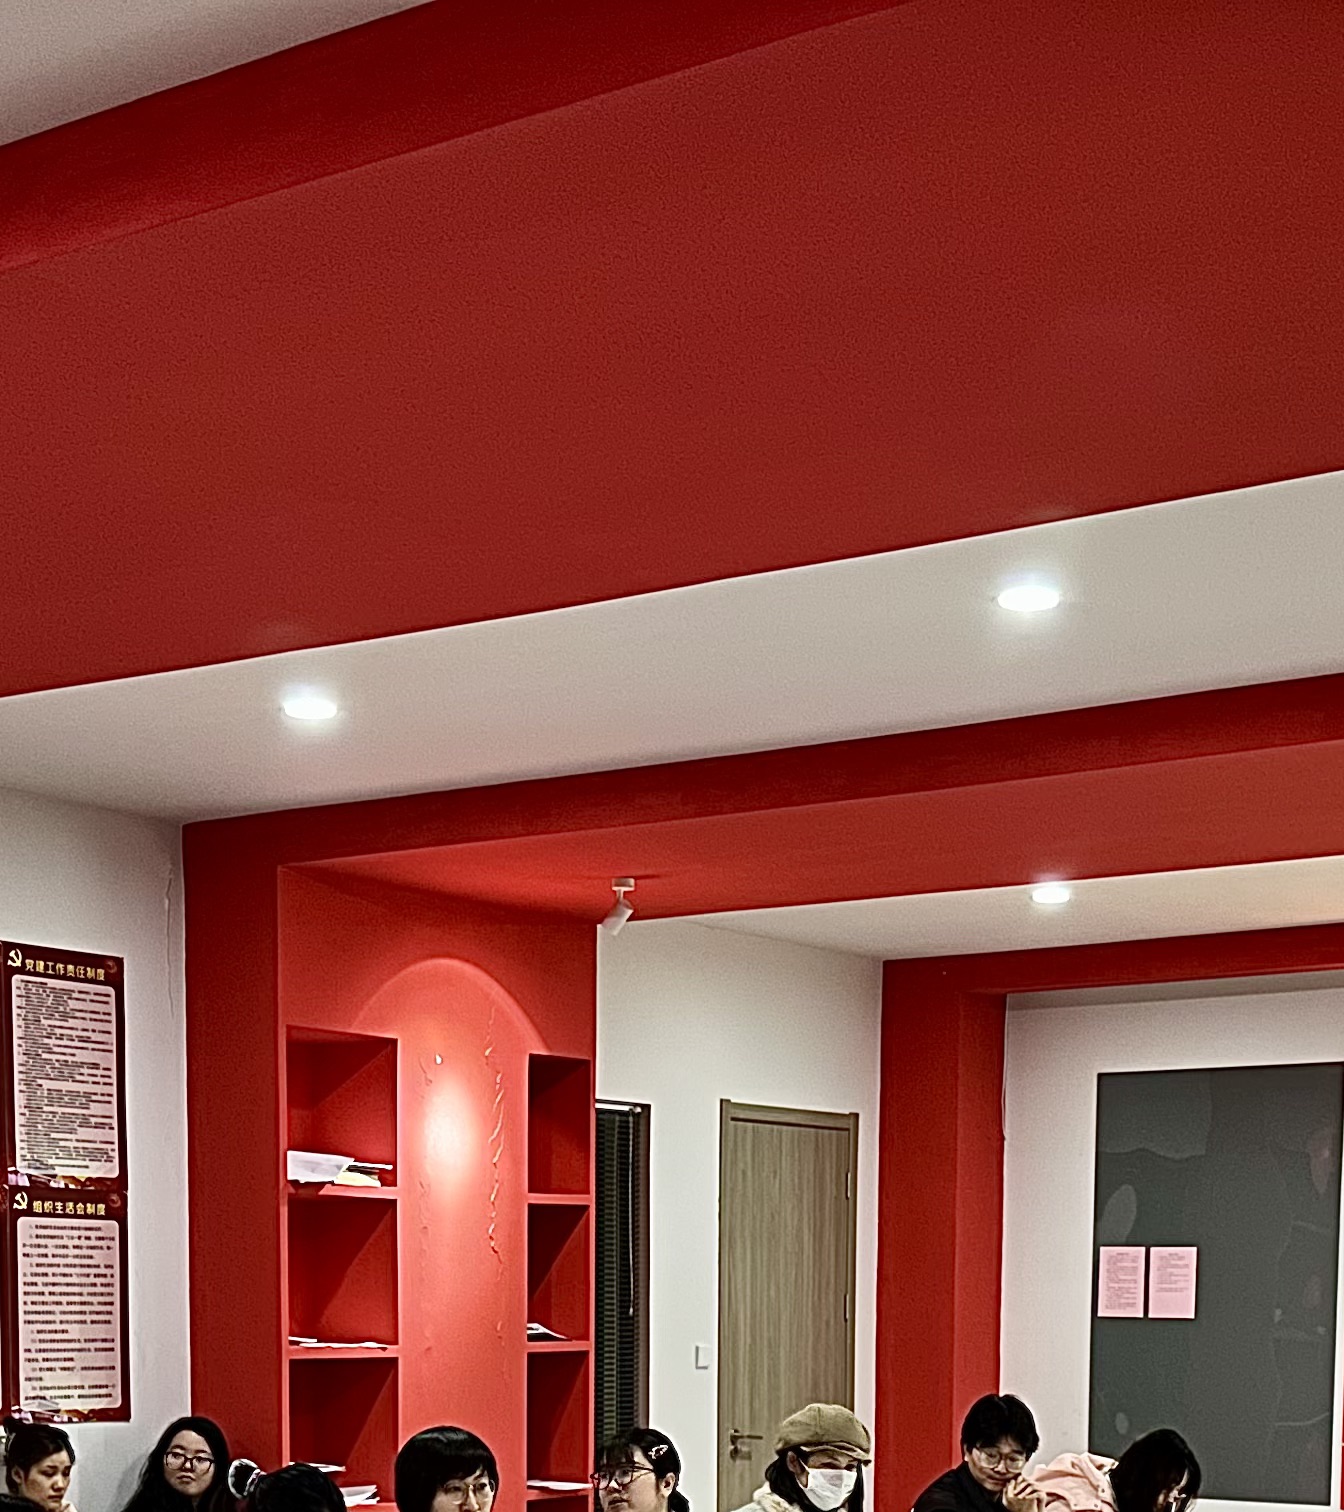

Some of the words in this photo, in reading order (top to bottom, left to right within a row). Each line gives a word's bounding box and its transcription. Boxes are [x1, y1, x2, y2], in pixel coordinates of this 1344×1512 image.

[24, 959, 106, 981] 党建工作责任制度
[32, 1200, 106, 1216] 组织生活会制度
